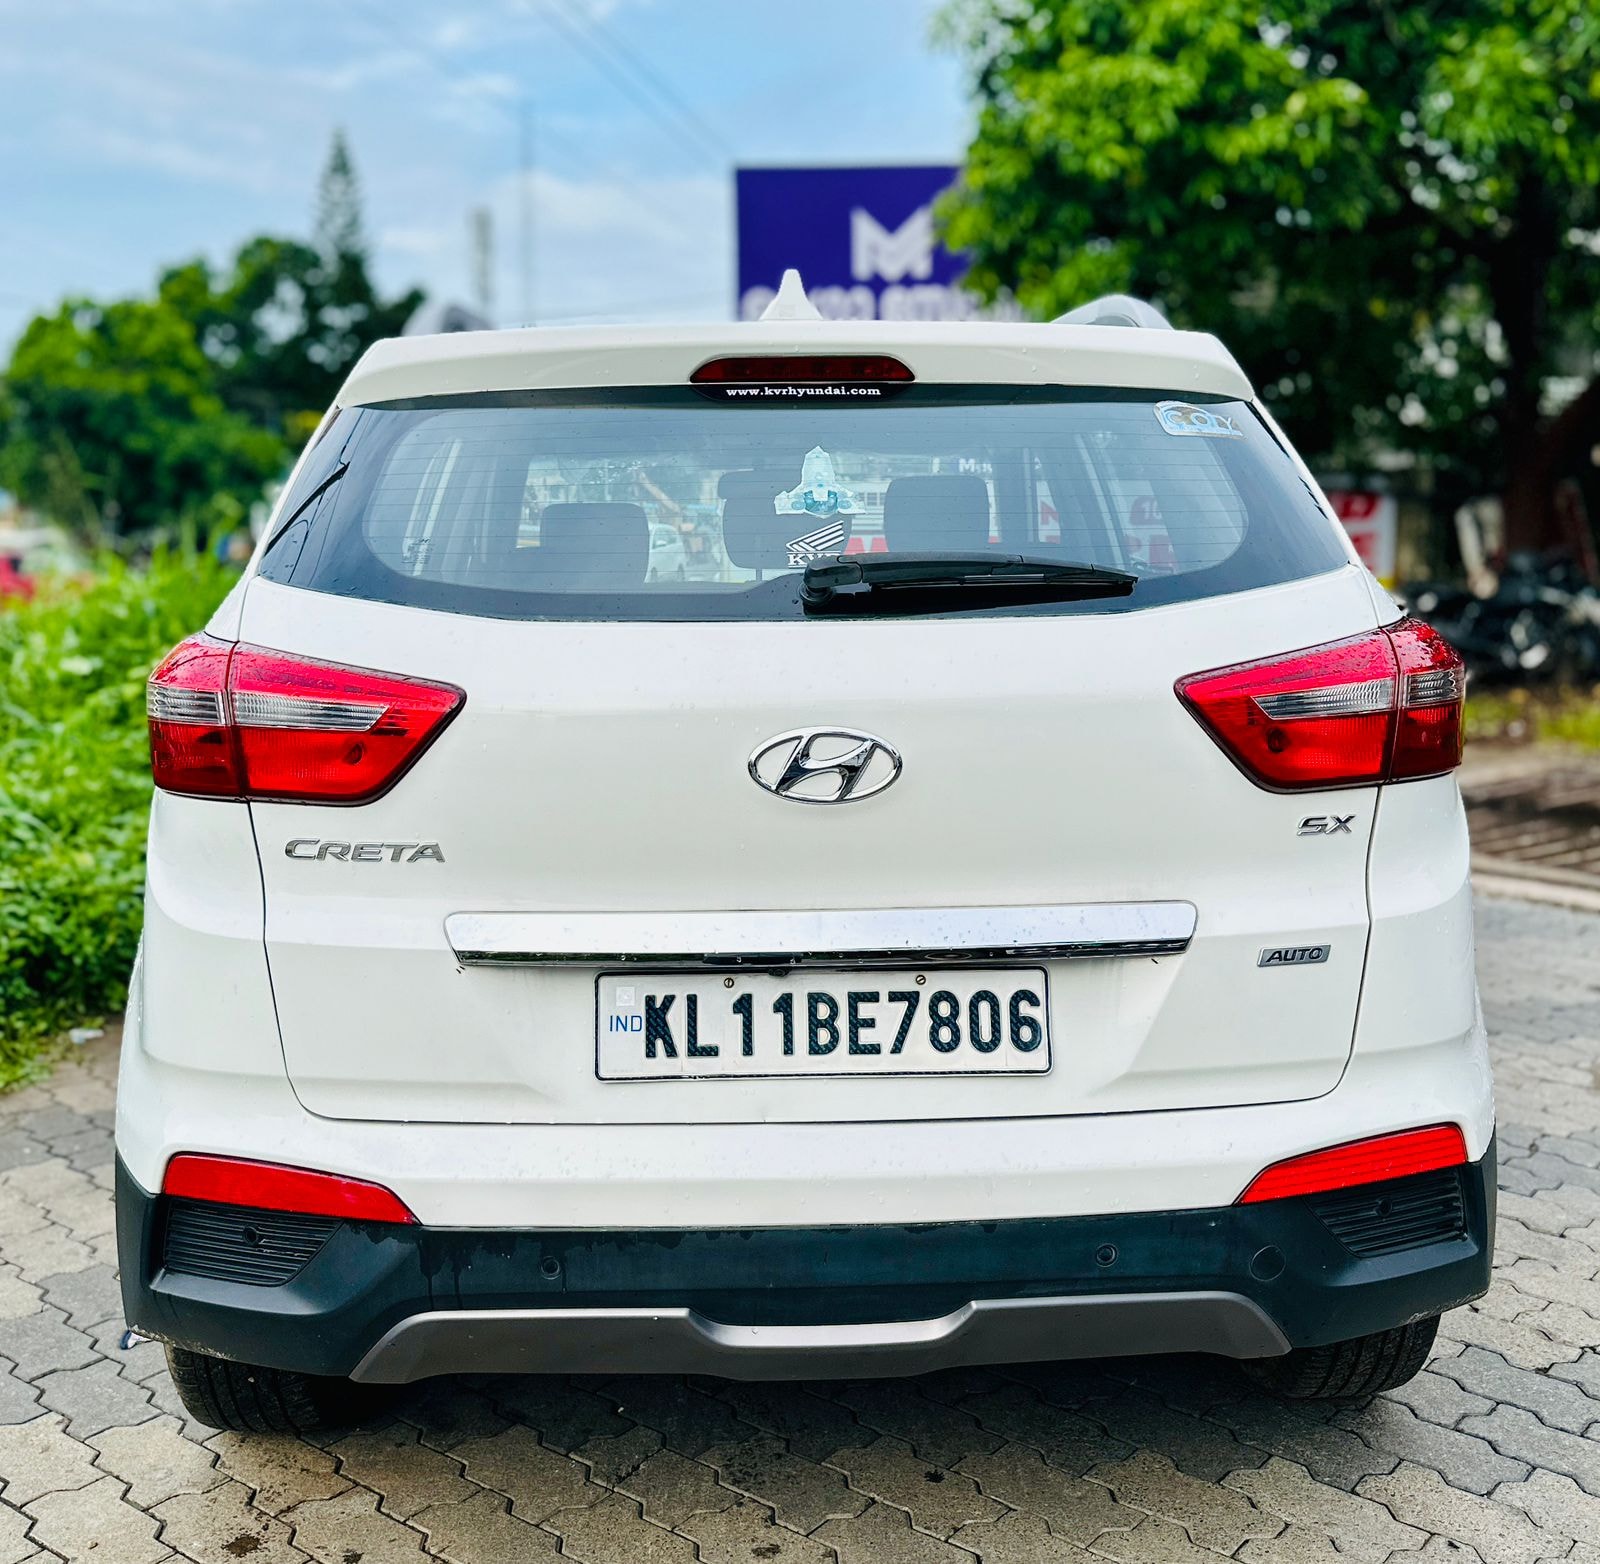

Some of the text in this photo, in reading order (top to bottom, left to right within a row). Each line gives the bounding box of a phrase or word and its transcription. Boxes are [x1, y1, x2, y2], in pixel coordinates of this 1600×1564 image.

[726, 386, 881, 397] www.kvrhyundai.com
[1297, 815, 1356, 836] SX
[284, 838, 446, 863] CRETA
[1265, 947, 1323, 963] AUTO
[609, 1014, 643, 1032] IND
[644, 990, 1041, 1058] KL11BE7806
